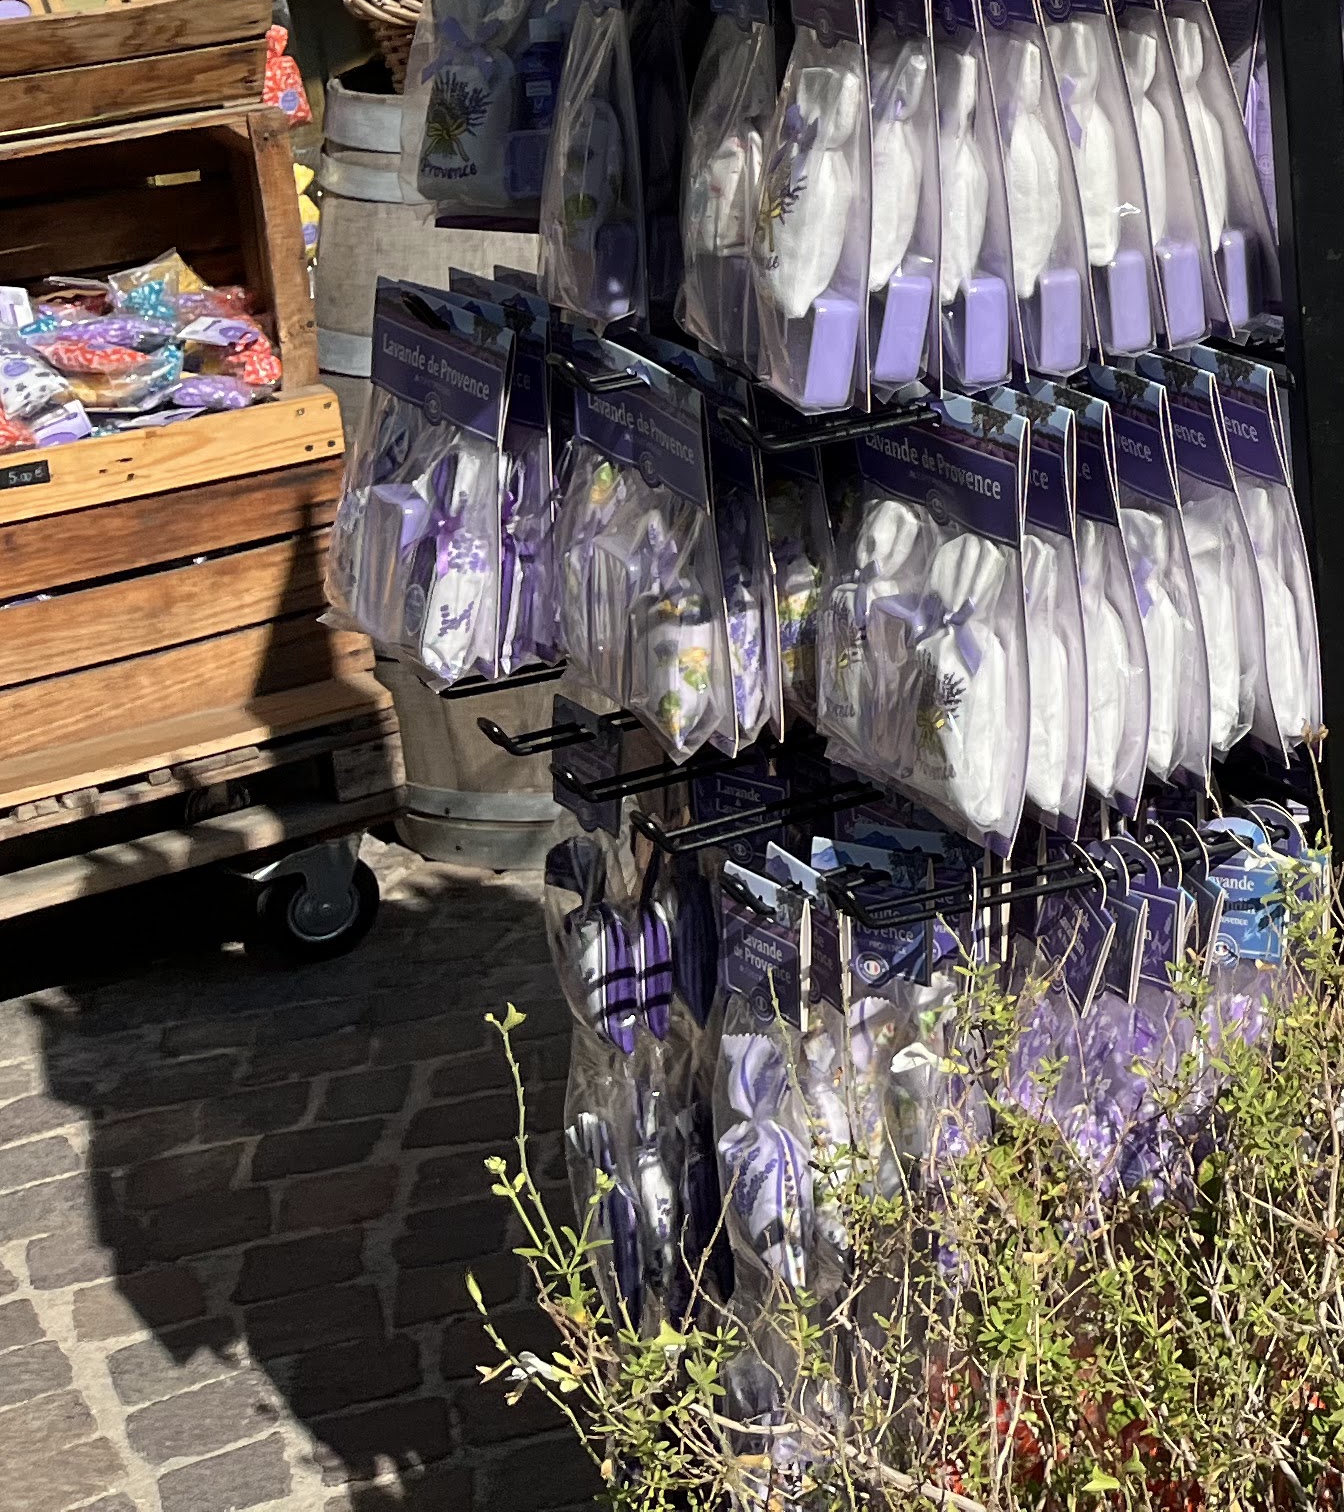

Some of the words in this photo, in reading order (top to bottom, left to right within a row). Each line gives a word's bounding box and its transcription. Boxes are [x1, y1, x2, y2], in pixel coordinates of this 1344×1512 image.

[382, 332, 427, 372] Lavande
[427, 354, 441, 377] de
[440, 358, 491, 402] Provence
[587, 391, 634, 430] Lavande
[636, 409, 650, 435] de
[649, 416, 696, 466] Provence
[1173, 422, 1208, 449] ence
[1223, 414, 1260, 443] ence
[864, 433, 920, 466] Lavande
[921, 447, 936, 473] de
[936, 452, 1002, 501] Provence
[739, 924, 784, 964] Lavande
